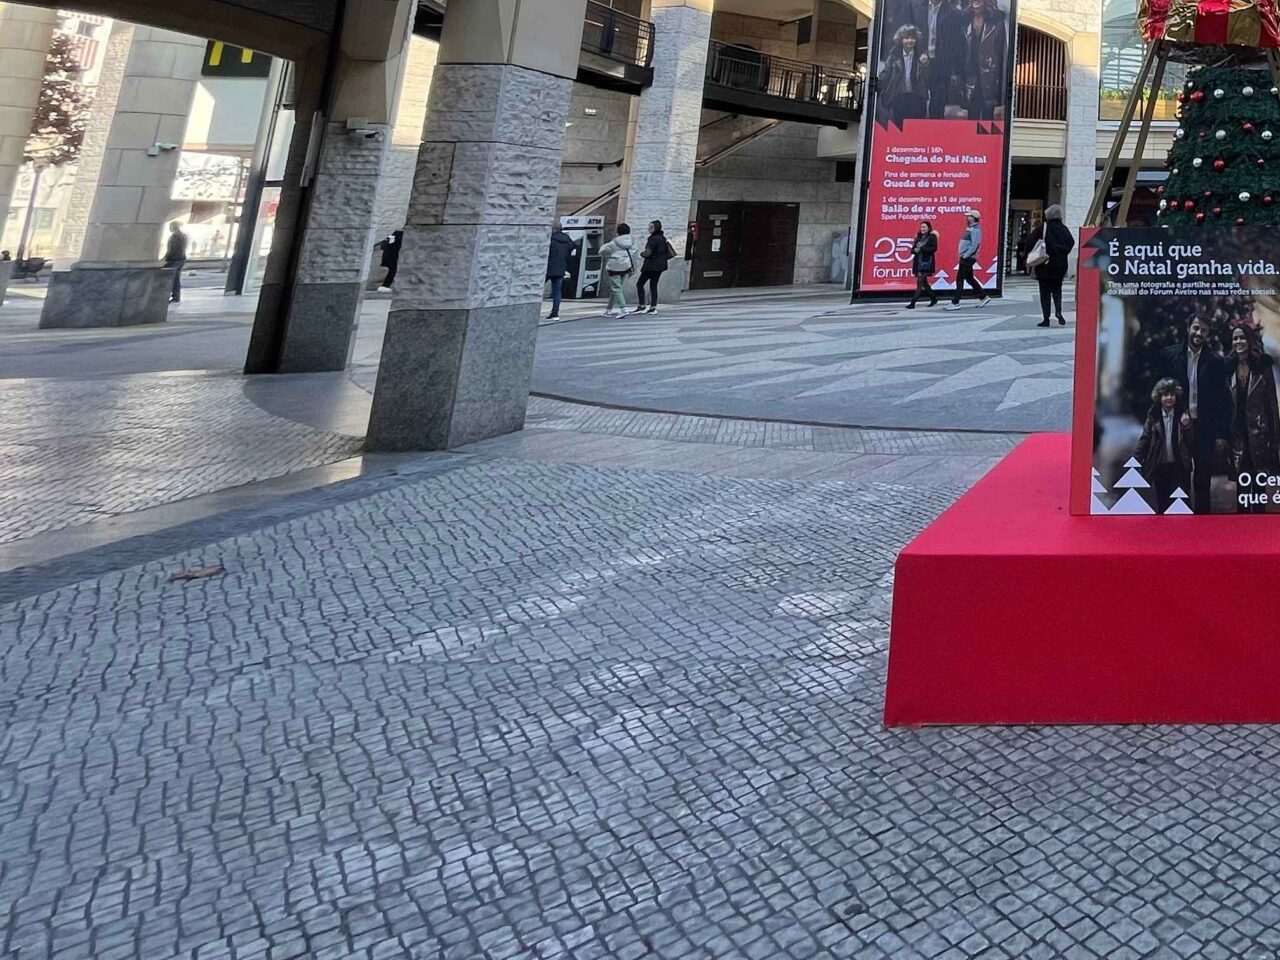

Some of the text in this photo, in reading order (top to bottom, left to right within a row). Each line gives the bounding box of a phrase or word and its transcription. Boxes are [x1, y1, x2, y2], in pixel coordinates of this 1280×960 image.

[885, 154, 928, 164] Chegada
[930, 155, 943, 163] do
[945, 155, 959, 163] Pai
[883, 180, 916, 188] Queda
[917, 180, 930, 188] de
[882, 205, 909, 213] Balão
[911, 205, 923, 213] de
[937, 206, 972, 215] quente
[873, 236, 916, 263] 25
[1109, 238, 1202, 260] É aqui que
[873, 265, 914, 278] forum
[1107, 259, 1280, 279] o Natal ganha vida.
[1140, 281, 1175, 289] fotografia
[1182, 281, 1211, 290] partilhe
[1217, 281, 1240, 289] magia
[1238, 472, 1252, 486] O
[1238, 493, 1268, 508] que
